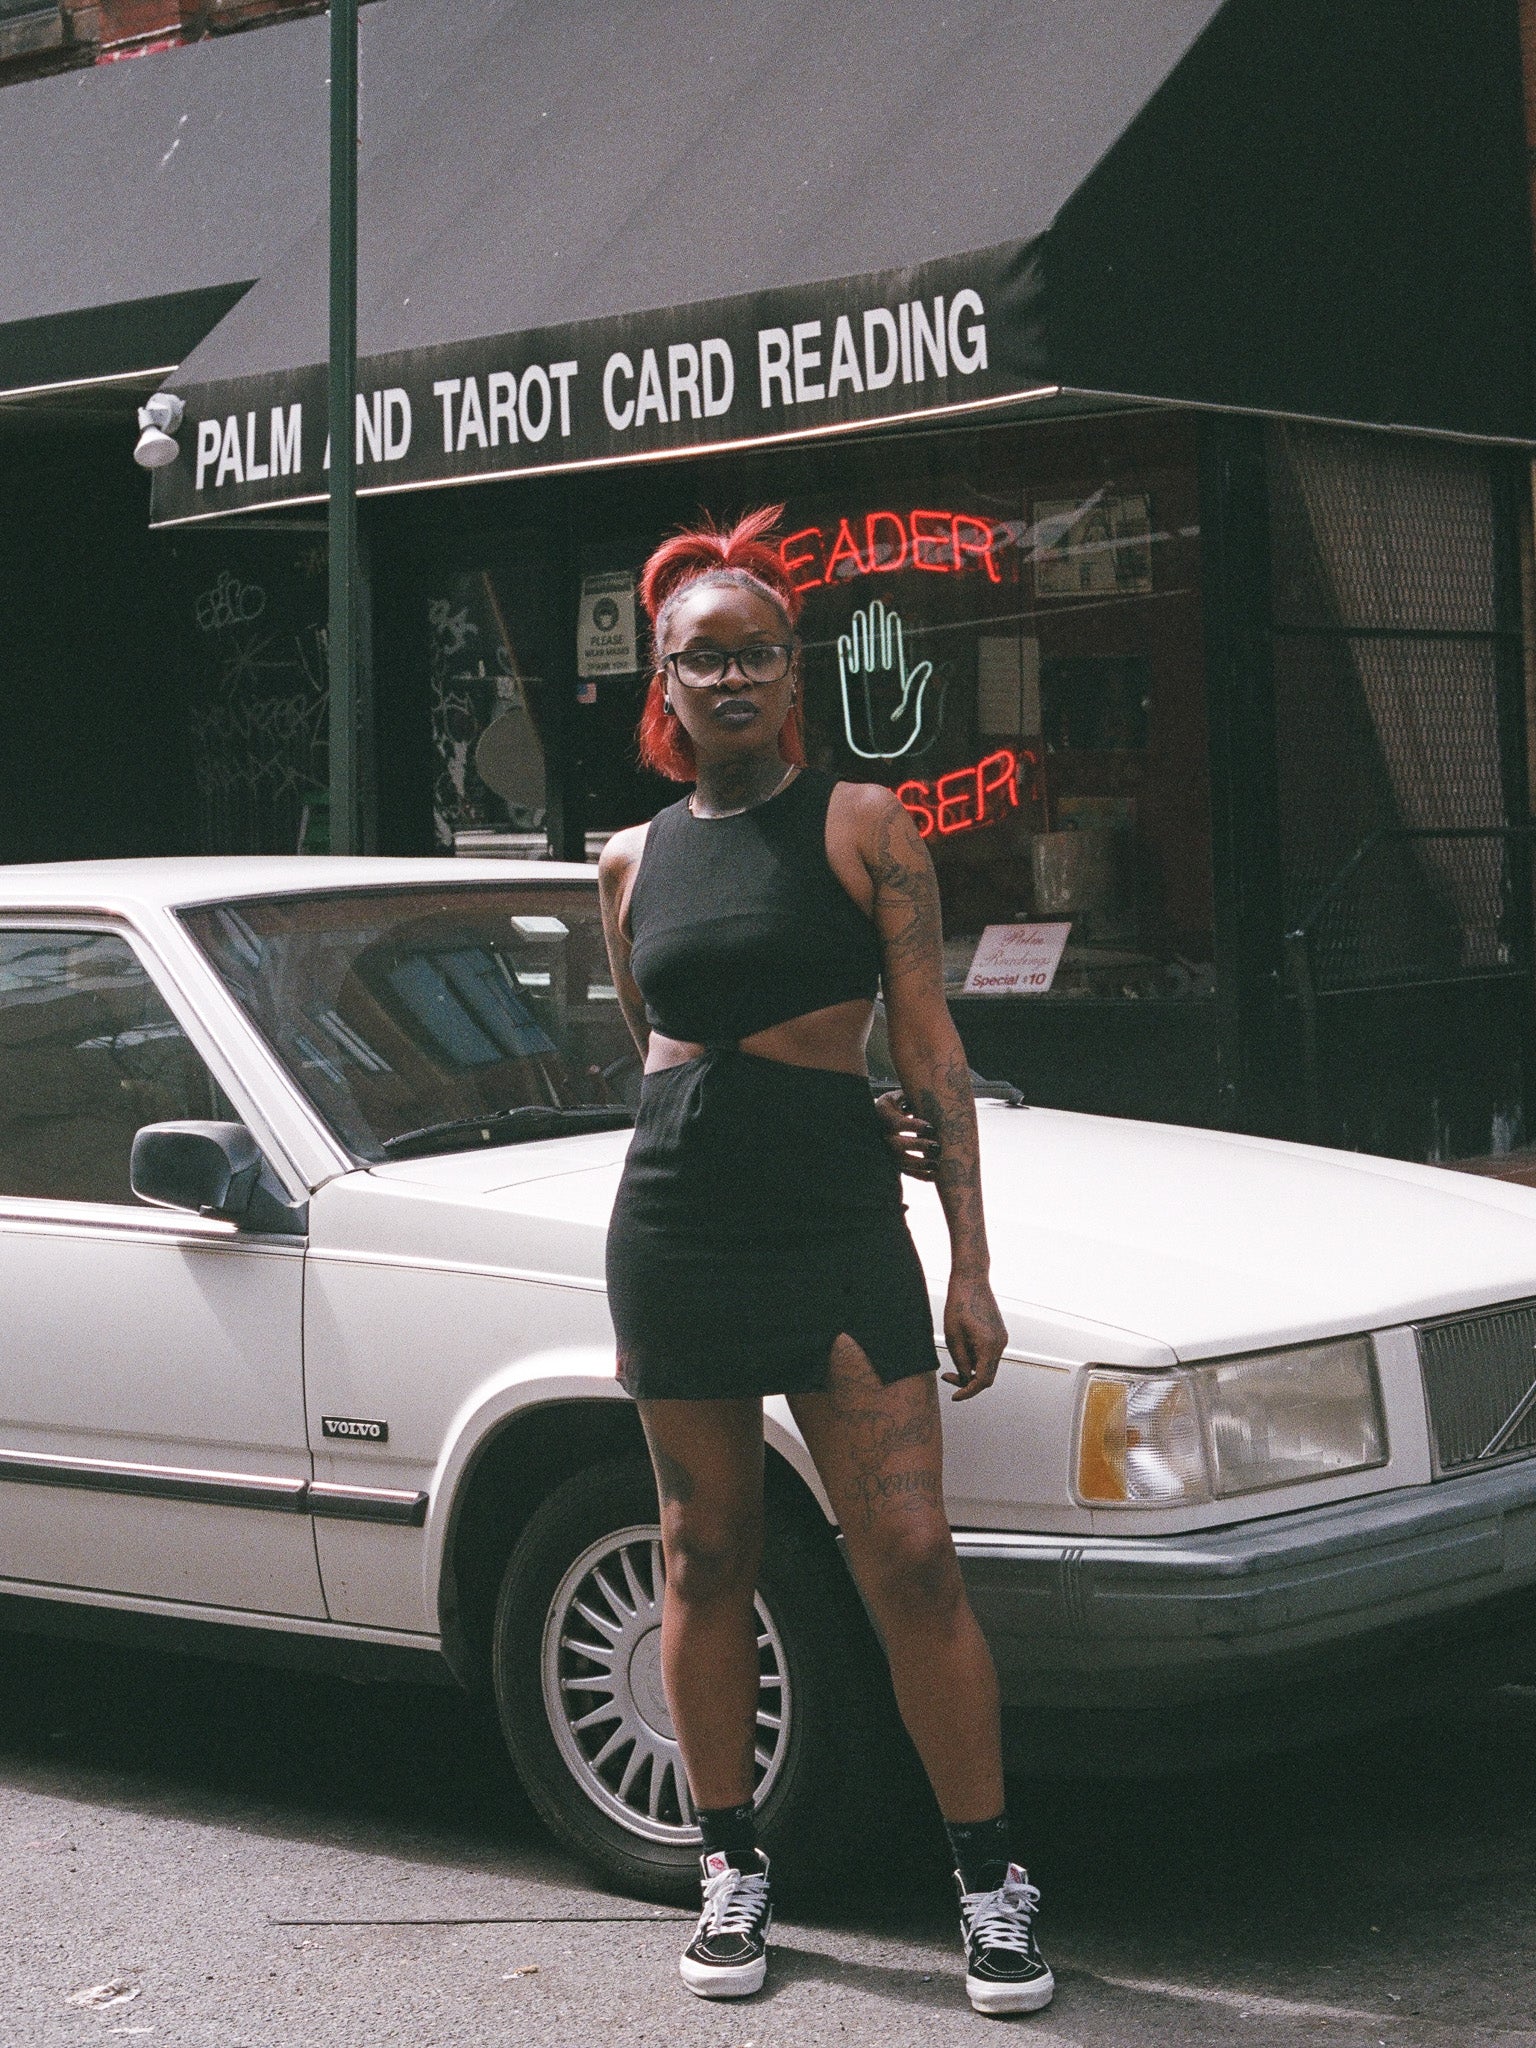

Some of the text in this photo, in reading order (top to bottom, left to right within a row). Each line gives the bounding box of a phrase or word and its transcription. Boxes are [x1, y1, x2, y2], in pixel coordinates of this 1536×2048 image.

[196, 288, 988, 490] PALM ND TAROT CARD READING
[780, 508, 1001, 592] EADER
[971, 973, 1020, 988] Special
[325, 1421, 380, 1437] VOLVO
